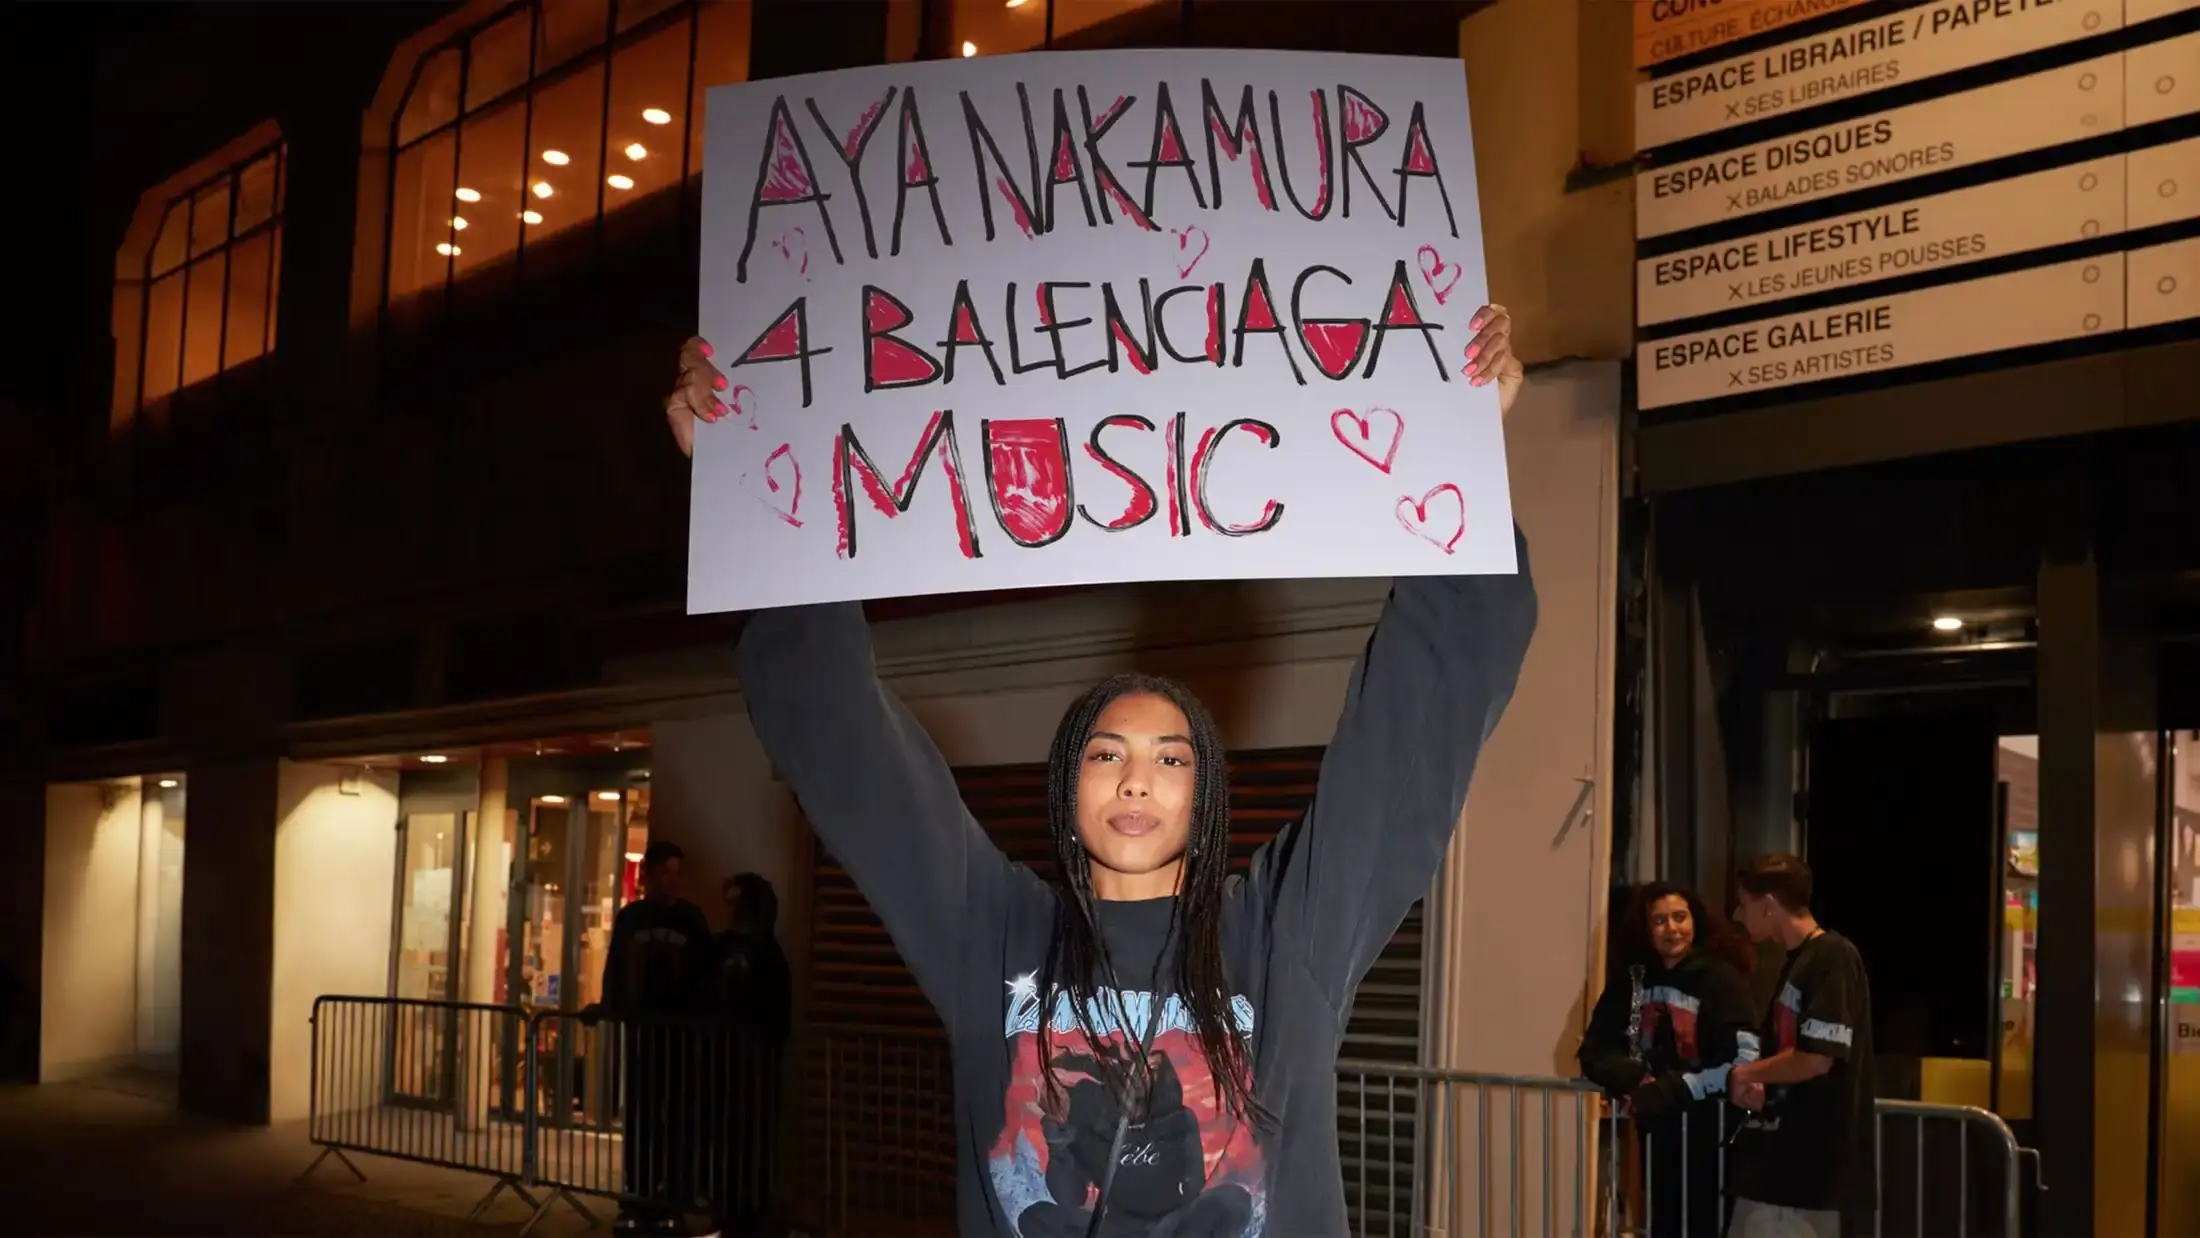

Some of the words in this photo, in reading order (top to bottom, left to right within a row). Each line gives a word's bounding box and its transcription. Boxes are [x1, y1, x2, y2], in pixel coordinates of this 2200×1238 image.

[1653, 61, 1755, 109] ESPACE
[1764, 20, 1906, 79] LIBRAIRIE
[1912, 14, 1925, 40] /
[1744, 89, 1785, 116] SES
[1789, 60, 1900, 104] LIBRAIRES
[736, 86, 953, 283] AYA
[958, 78, 1461, 240] NAKAMURA
[1653, 153, 1758, 199] ESPACE
[1765, 119, 1893, 171] DISQUES
[1745, 169, 1841, 207] BALADES
[1845, 142, 1955, 184] SONORES
[1655, 243, 1760, 287] ESPACE
[1767, 208, 1921, 262] LIFESTYLE
[1747, 273, 1786, 299] LES
[1790, 256, 1873, 290] JEUNES
[1879, 233, 1987, 274] POUSSES
[731, 297, 833, 407] 4
[863, 257, 1449, 393] BALENCIAGA
[1655, 331, 1759, 371] ESPACE
[1767, 305, 1893, 349] GALERIE
[1747, 360, 1788, 384] SES
[1792, 343, 1895, 378] ARTISTES
[833, 410, 1286, 562] MUSIC
